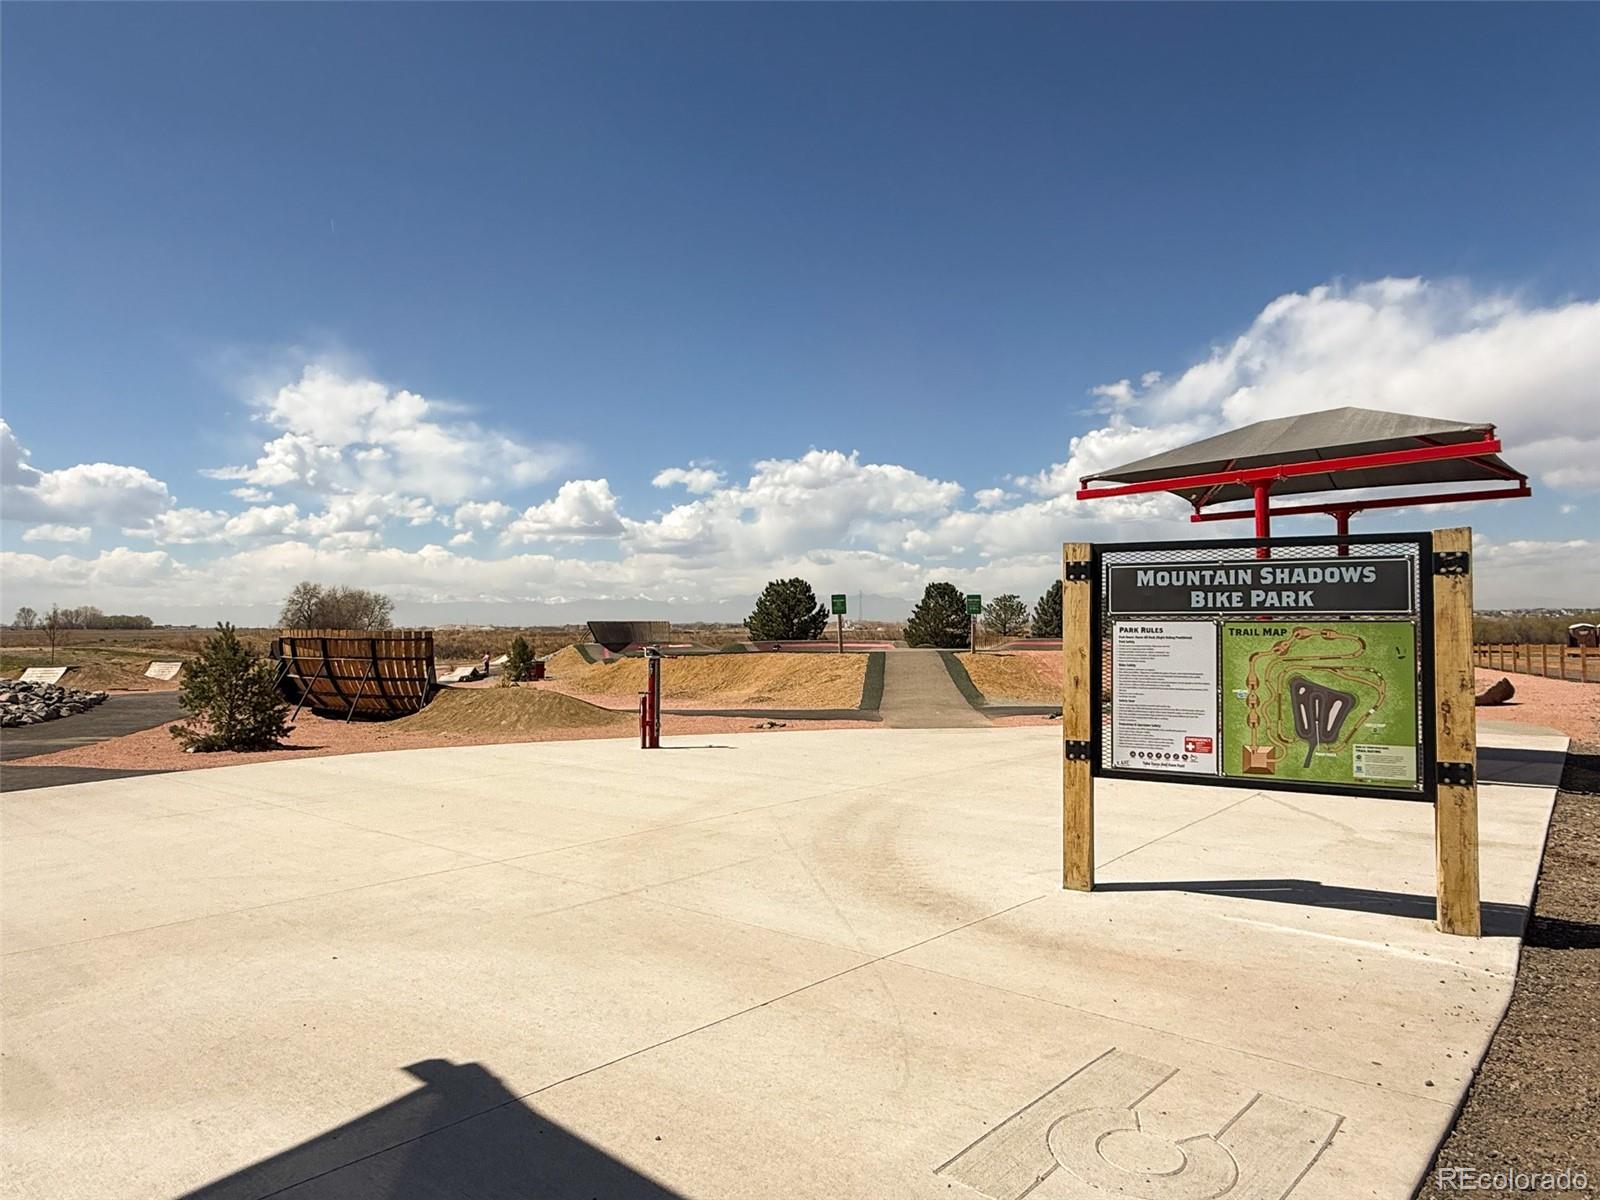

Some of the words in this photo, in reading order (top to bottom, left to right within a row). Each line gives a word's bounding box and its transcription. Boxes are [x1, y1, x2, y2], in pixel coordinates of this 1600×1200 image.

[1136, 568, 1253, 587] MOUNTAIN
[1260, 566, 1377, 585] SHADOWS
[1190, 590, 1244, 608] BIKE
[1250, 589, 1315, 608] PARK
[1119, 626, 1139, 634] PARK
[1140, 626, 1164, 634] RULES
[1229, 627, 1260, 637] TRAIL
[1262, 627, 1288, 637] MAP
